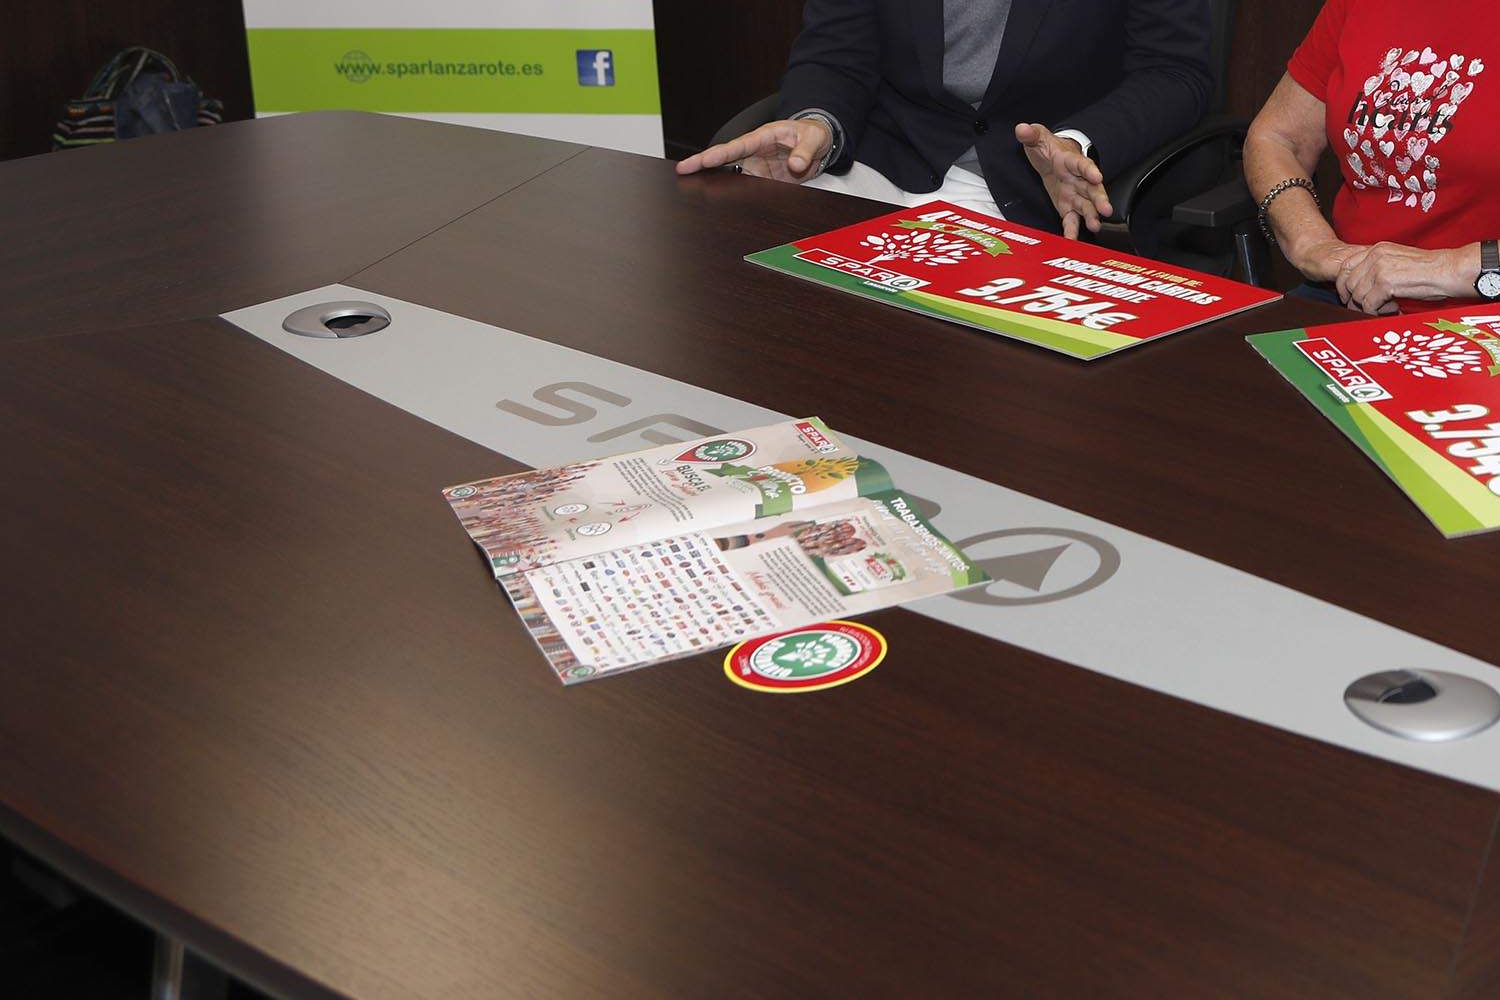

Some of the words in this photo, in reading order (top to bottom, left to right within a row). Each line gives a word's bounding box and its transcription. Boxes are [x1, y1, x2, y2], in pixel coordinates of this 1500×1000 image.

[334, 59, 544, 77] www.sparlanzarote.es
[819, 256, 895, 281] SPAR
[1042, 256, 1151, 286] ASOCIACIÓN
[1137, 280, 1222, 305] CÁRITAS
[955, 277, 1140, 331] 3.754€
[1049, 273, 1158, 304] LANZAROTE
[1312, 349, 1367, 387] SPAR
